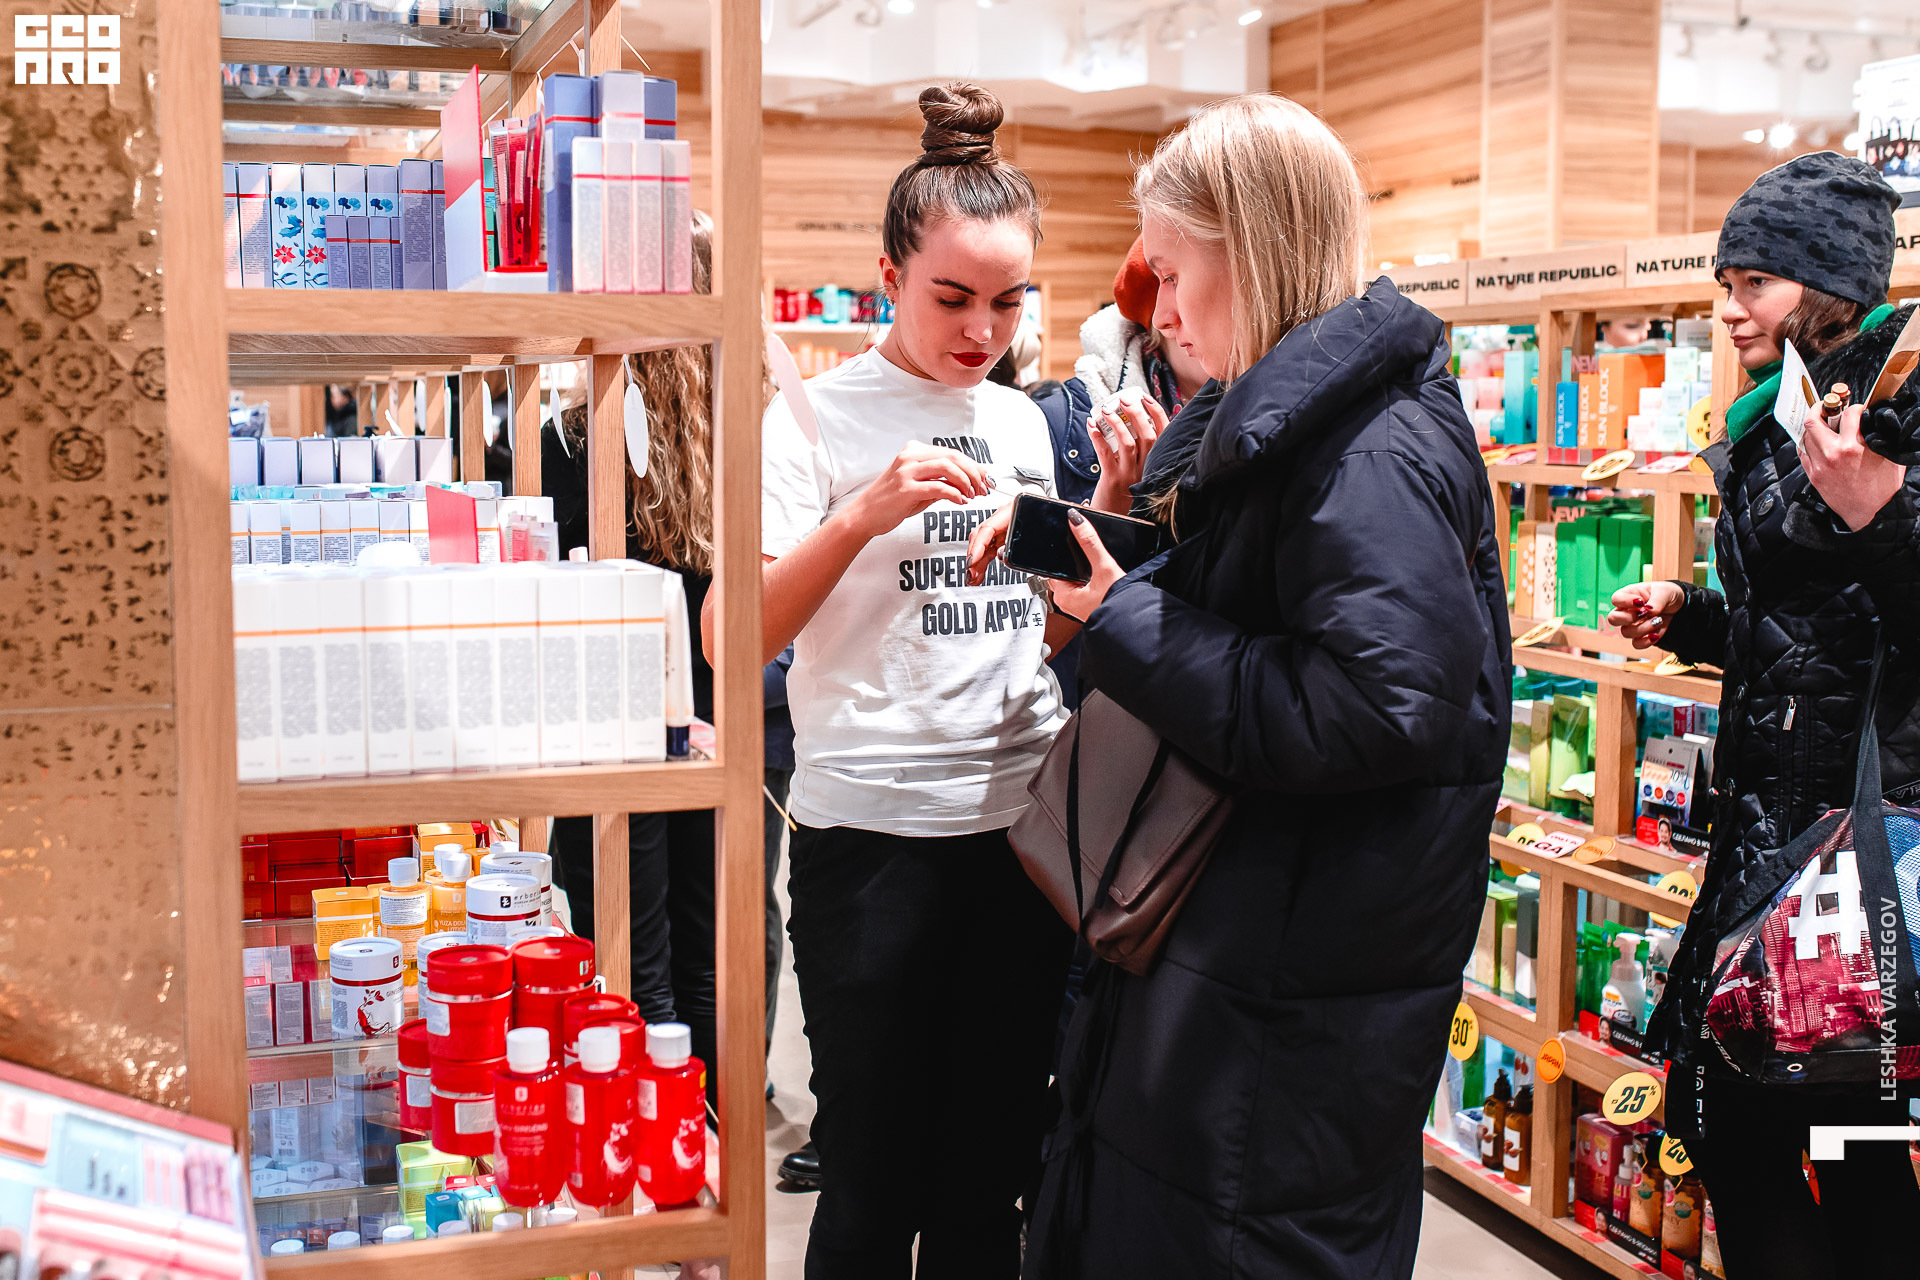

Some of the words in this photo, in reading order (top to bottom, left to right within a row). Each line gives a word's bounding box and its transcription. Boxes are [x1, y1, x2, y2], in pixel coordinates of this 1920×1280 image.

[1637, 254, 1706, 274] NATURE
[1397, 278, 1460, 294] REPUBLIC
[1476, 271, 1534, 288] NATURE
[1538, 264, 1617, 283] REPUBLIC
[1572, 355, 1599, 374] NEW
[1580, 385, 1590, 421] BLOCK
[1599, 368, 1609, 415] BLOCK
[1557, 424, 1565, 446] SUN
[1580, 423, 1589, 446] SUN
[1597, 416, 1608, 446] SUN
[1547, 505, 1586, 525] NEW
[921, 602, 978, 636] GOLD
[984, 597, 1034, 634] APPL
